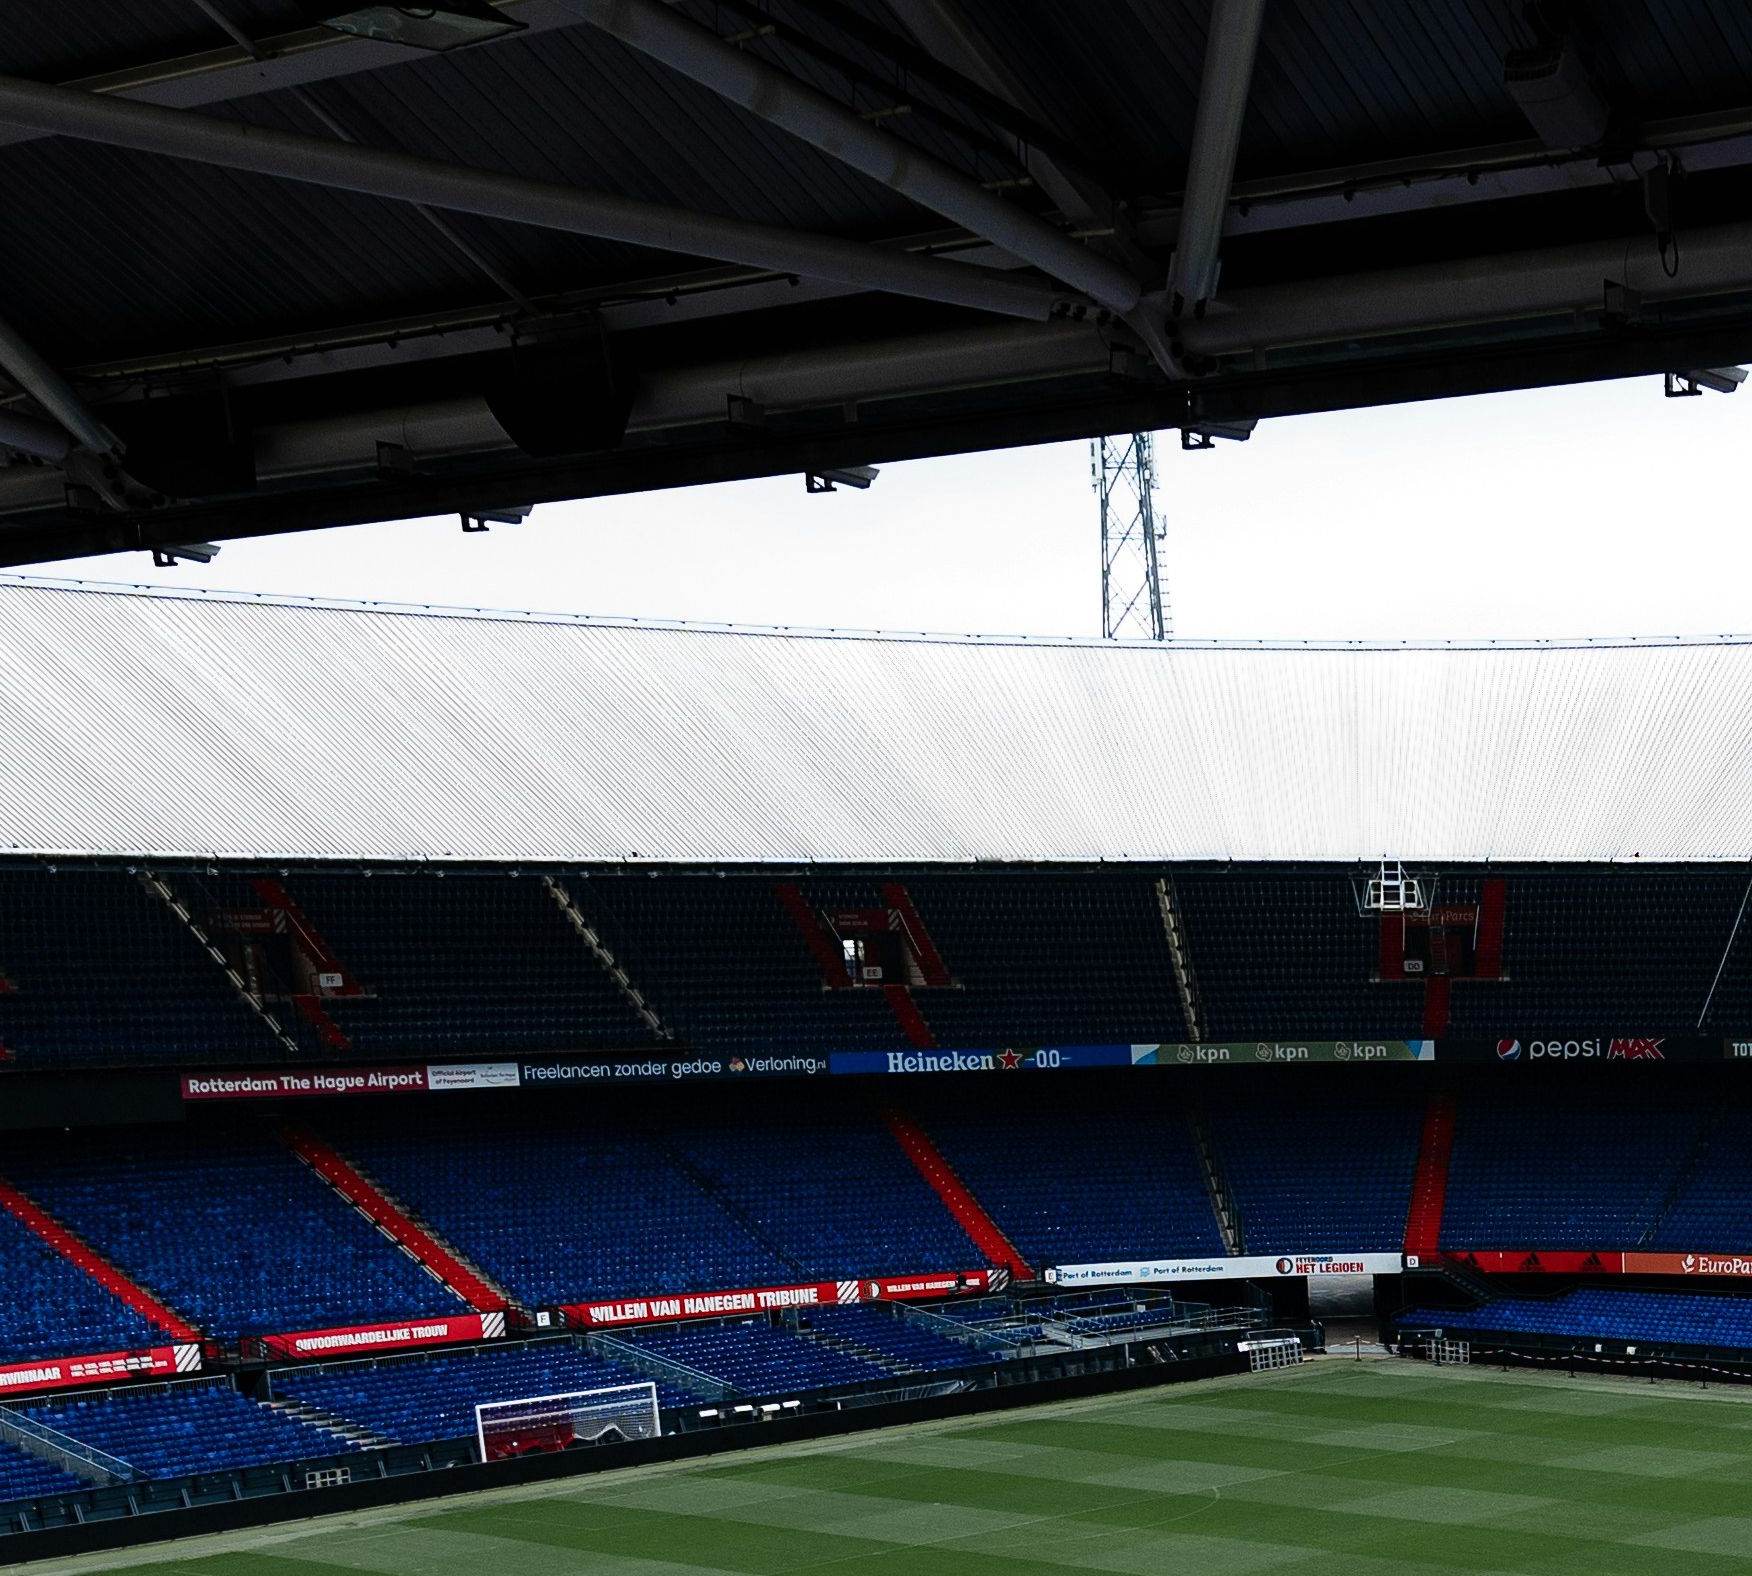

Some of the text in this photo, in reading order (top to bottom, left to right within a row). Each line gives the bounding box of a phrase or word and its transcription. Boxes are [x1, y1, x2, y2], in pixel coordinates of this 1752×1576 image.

[1195, 1045, 1231, 1063] kpn
[1275, 1043, 1309, 1062] kpn
[1353, 1042, 1387, 1060] kpn
[1529, 1037, 1666, 1060] pepsi MAX
[524, 1063, 611, 1080] Freelancen
[614, 1060, 666, 1076] zonder
[671, 1059, 721, 1078] gedoe
[744, 1055, 826, 1074] Verloning.nl
[886, 1051, 996, 1073] Heineken
[189, 1071, 423, 1094] Rotterdam The Hague Airport
[1170, 1266, 1179, 1274] of
[1181, 1265, 1224, 1273] Rotterdam
[1296, 1262, 1364, 1274] HET LEGIOEN
[1409, 1258, 1416, 1266] D
[590, 1287, 819, 1322] WILLEM VAN HANEGEM TRIBUNE
[296, 1324, 448, 1351] ONVOORWAARDELIJKE TROUW
